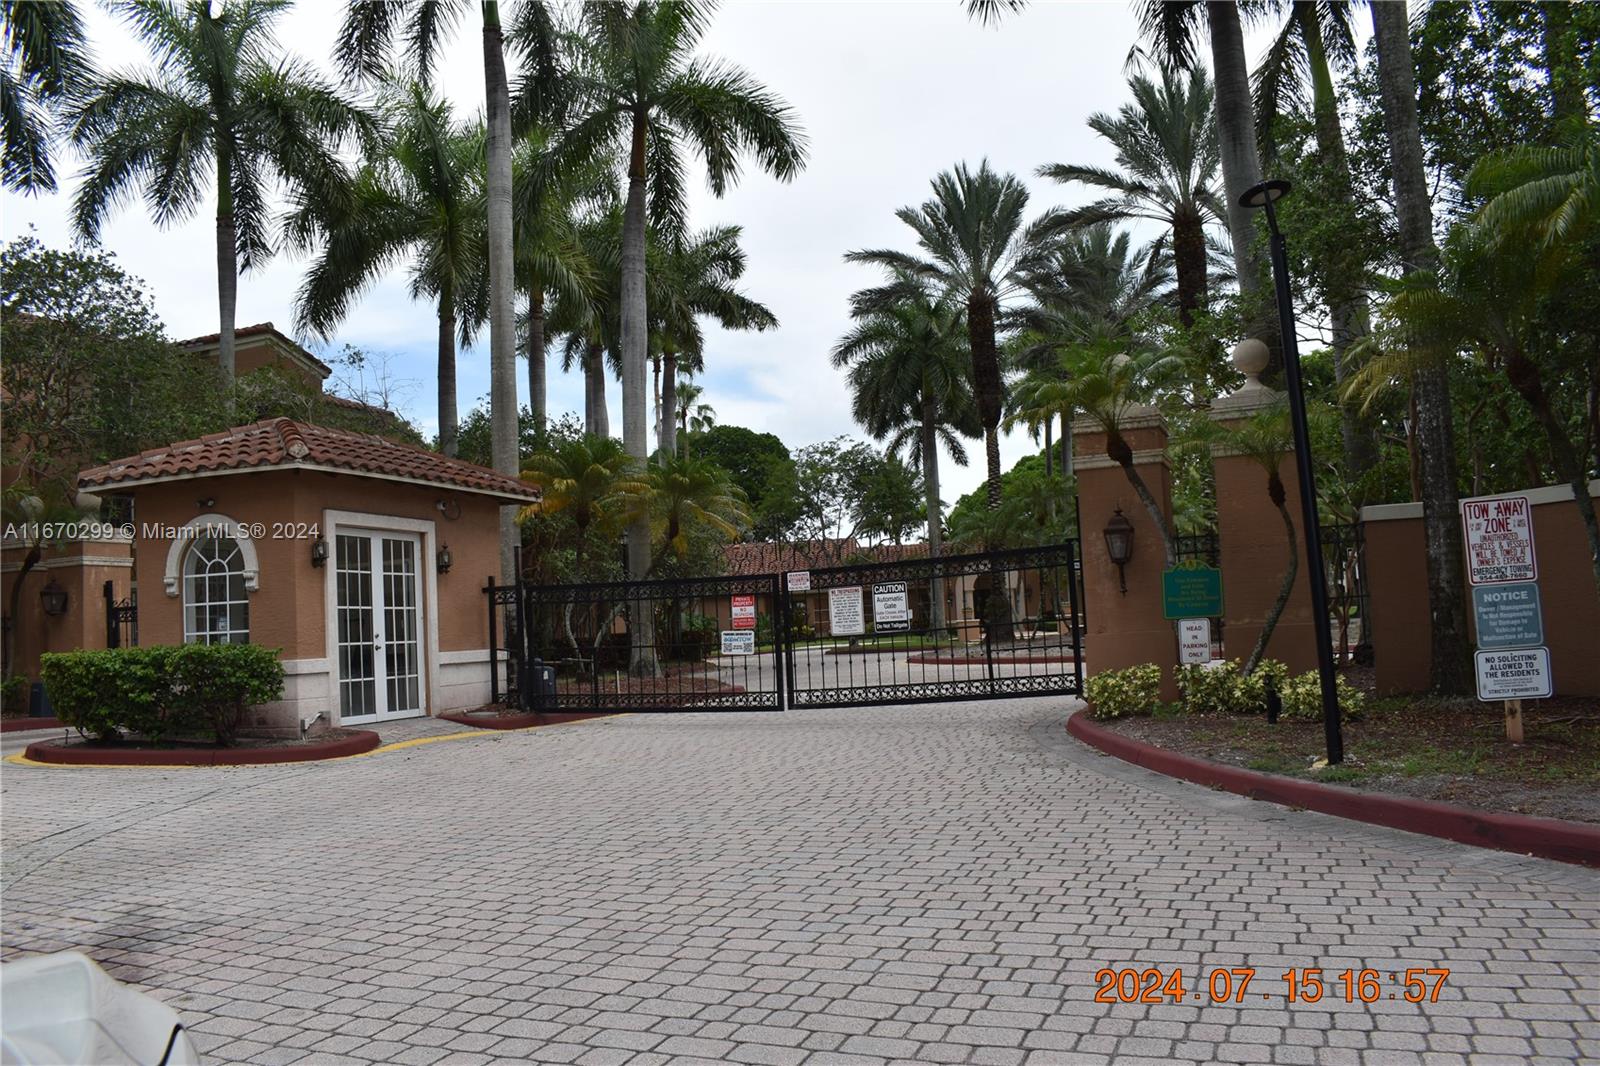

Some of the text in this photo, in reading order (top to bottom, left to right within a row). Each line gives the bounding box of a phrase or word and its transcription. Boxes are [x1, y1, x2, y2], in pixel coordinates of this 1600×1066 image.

[1467, 500, 1525, 519] TOW AWAY
[1484, 517, 1512, 533] ZONE
[1480, 532, 1519, 542] UNAUTHORIZED
[1471, 543, 1496, 551] VEHICLES
[1507, 540, 1529, 548] VESSELS
[1500, 548, 1518, 557] TOWED
[1477, 556, 1526, 566] OWNER'S EXPENSE
[1473, 564, 1532, 576] EMERGENCY TOWING
[874, 584, 905, 593] CAUTION
[1483, 591, 1529, 602] NOTICE
[1497, 654, 1537, 663] SOLICITING
[1489, 662, 1523, 670] ALLOWED
[1500, 669, 1541, 677] RESIDENTS
